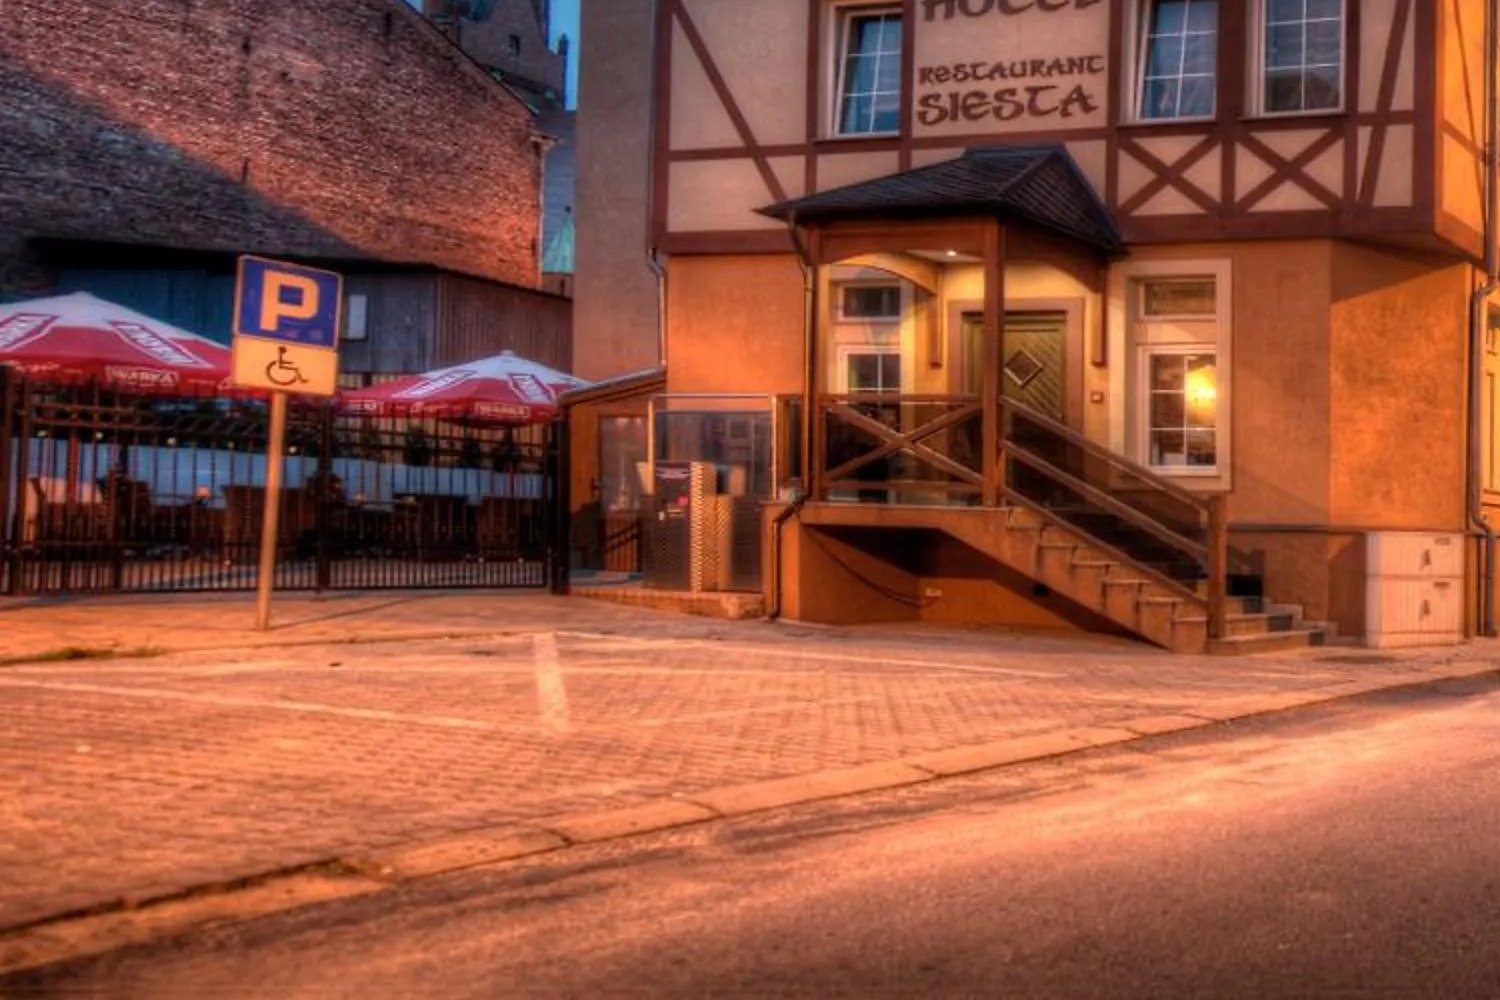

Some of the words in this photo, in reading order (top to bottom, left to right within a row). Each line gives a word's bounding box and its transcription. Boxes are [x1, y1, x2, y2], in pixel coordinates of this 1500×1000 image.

[919, 55, 1105, 85] RESTAURANT
[917, 84, 1098, 126] SIESTA
[260, 269, 319, 331] P
